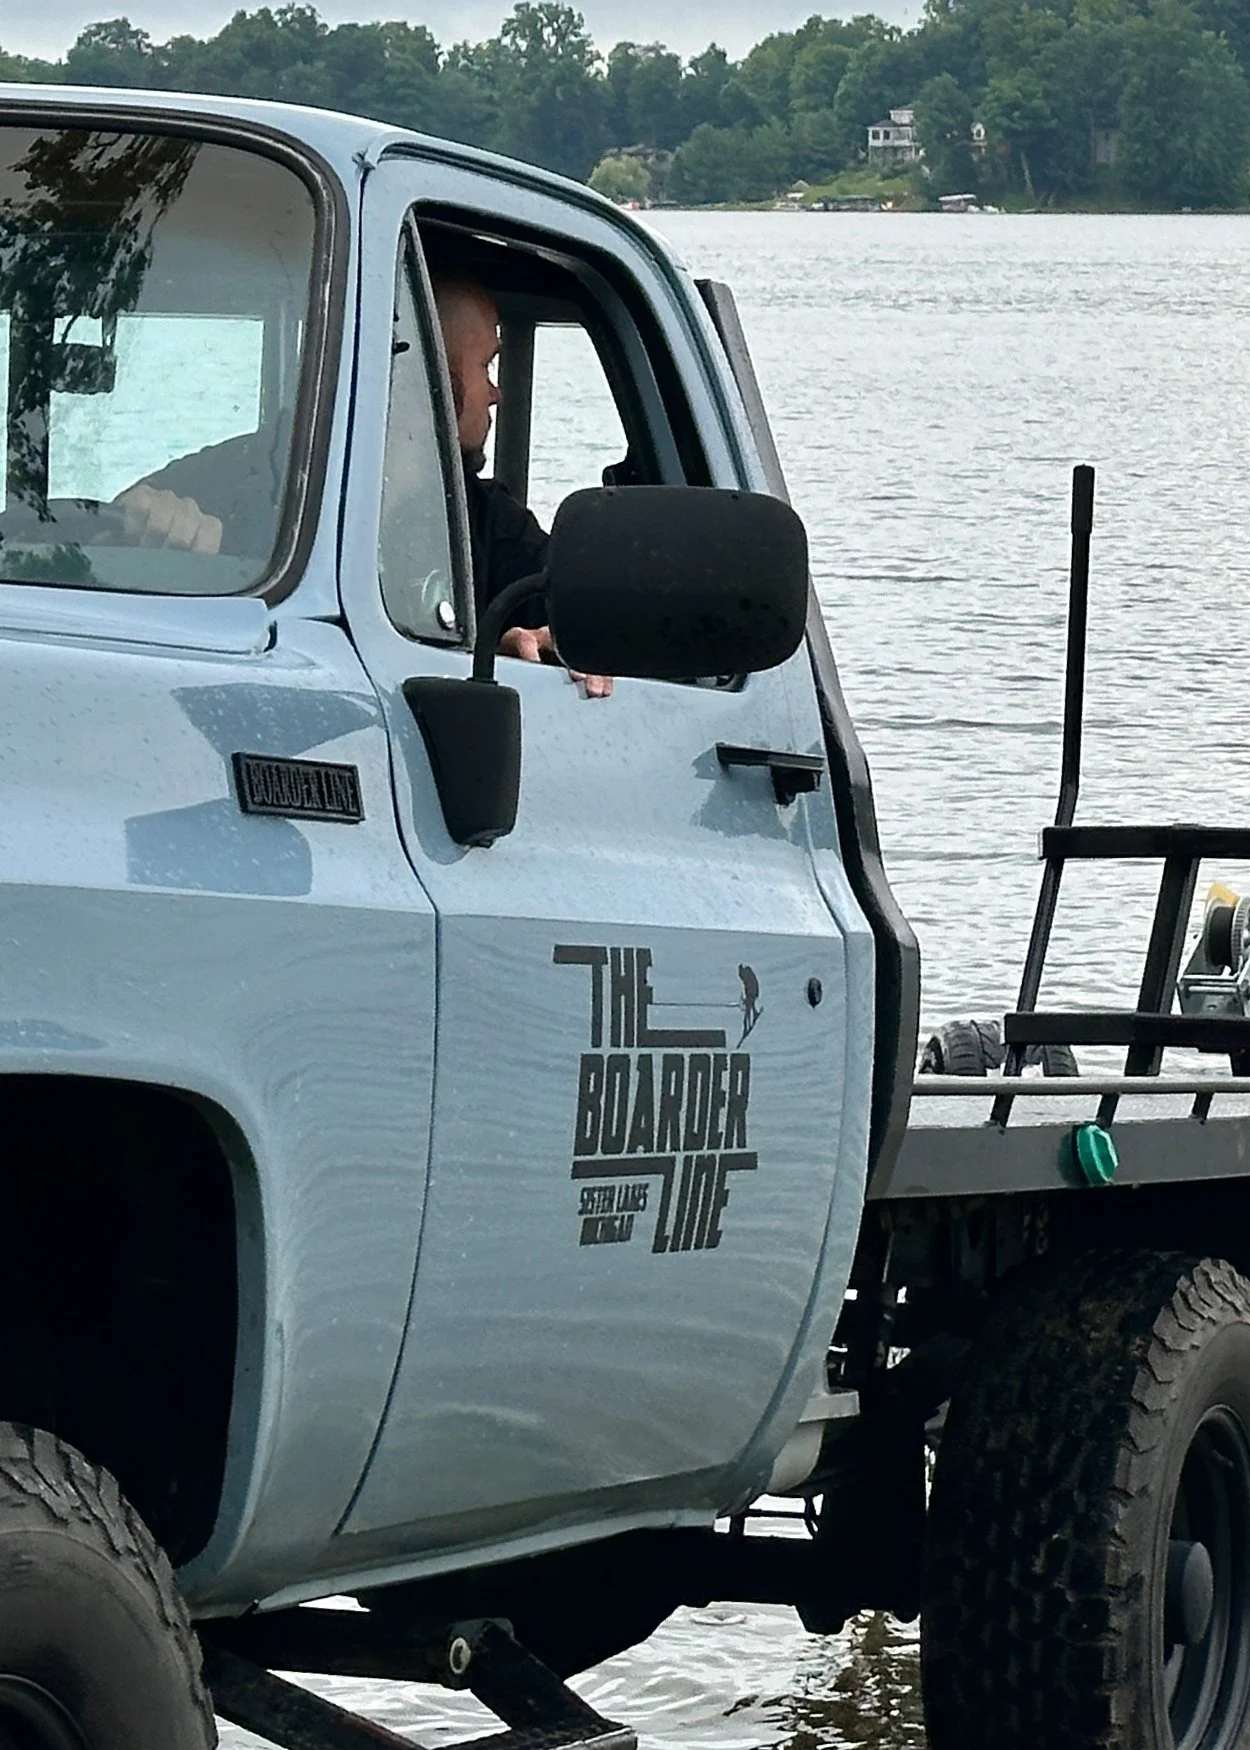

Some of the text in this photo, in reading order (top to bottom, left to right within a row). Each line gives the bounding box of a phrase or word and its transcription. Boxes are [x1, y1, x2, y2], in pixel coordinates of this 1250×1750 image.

[322, 769, 358, 813] LINE
[553, 944, 726, 1048] THE
[573, 1053, 751, 1156] BOARDER
[570, 1152, 758, 1254] LINE
